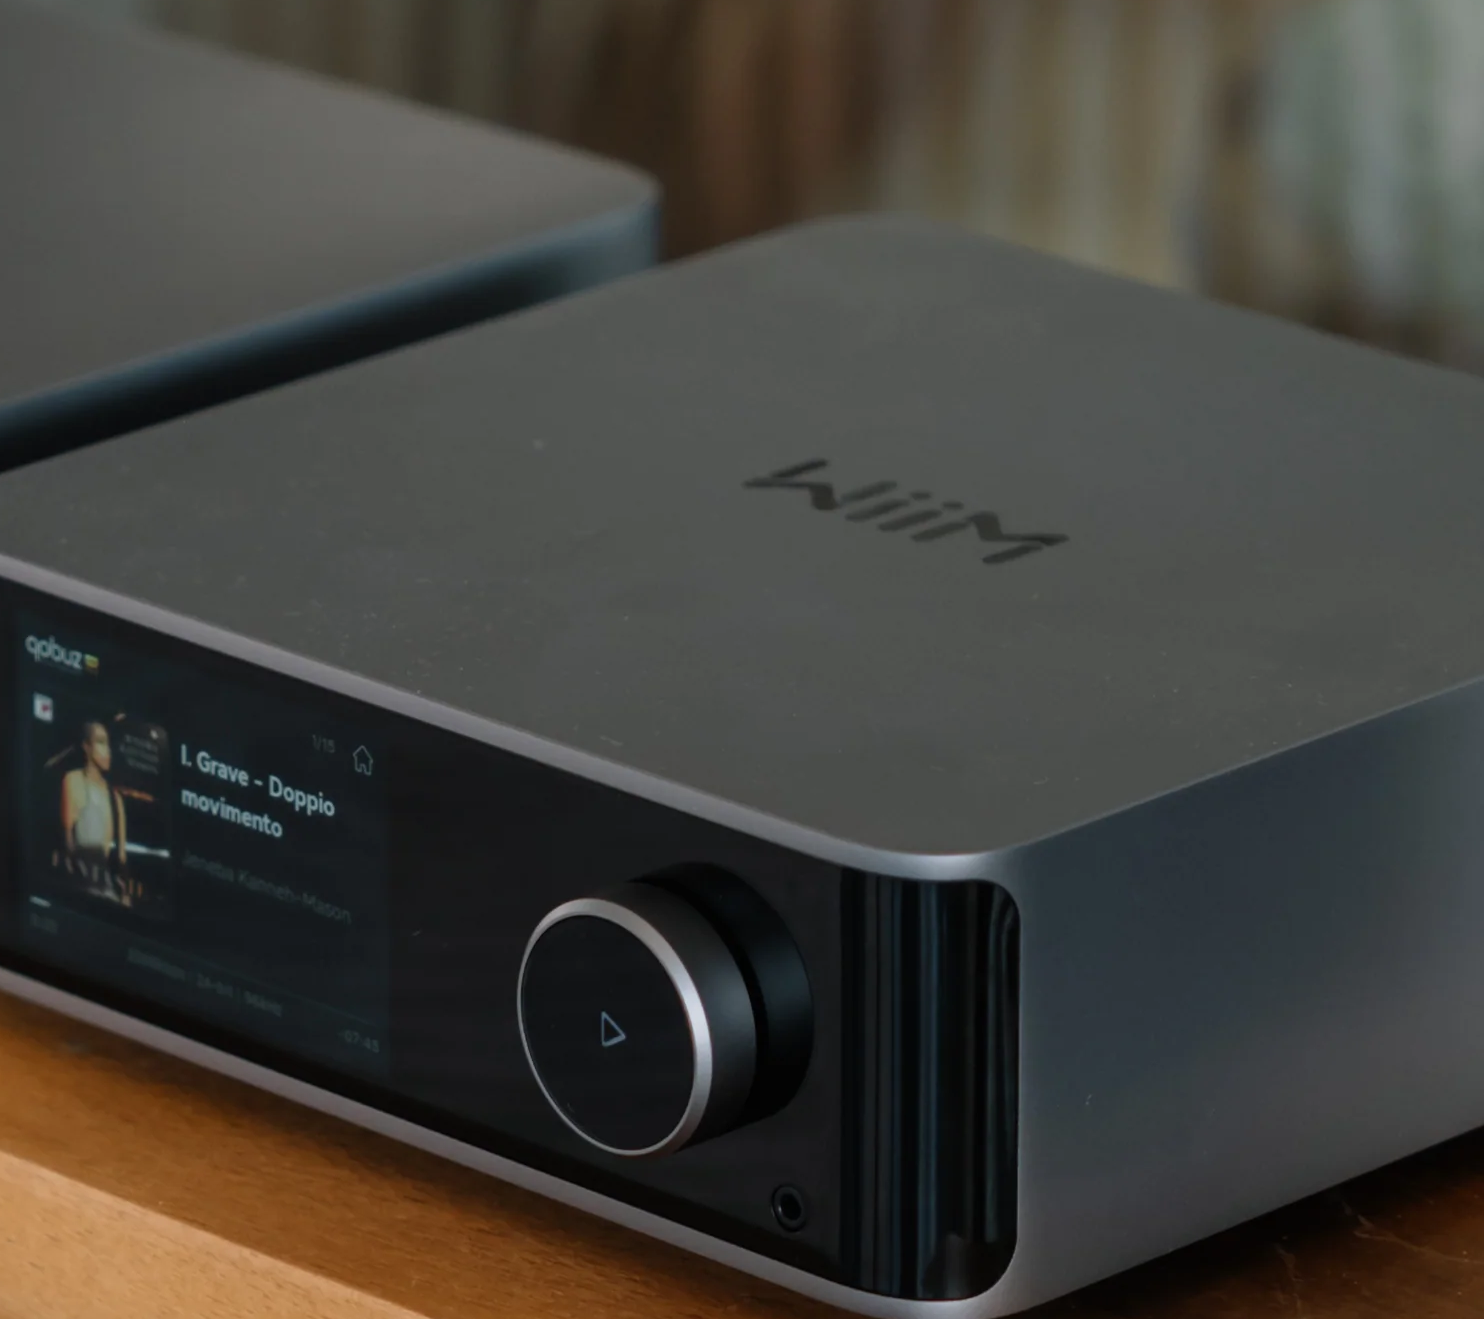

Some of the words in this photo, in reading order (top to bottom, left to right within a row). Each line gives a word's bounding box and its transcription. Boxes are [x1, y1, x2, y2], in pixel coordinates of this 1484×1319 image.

[743, 458, 1070, 565] WiiM
[181, 788, 283, 838] movimento
[197, 752, 249, 787] Grave
[269, 775, 335, 817] Doppio
